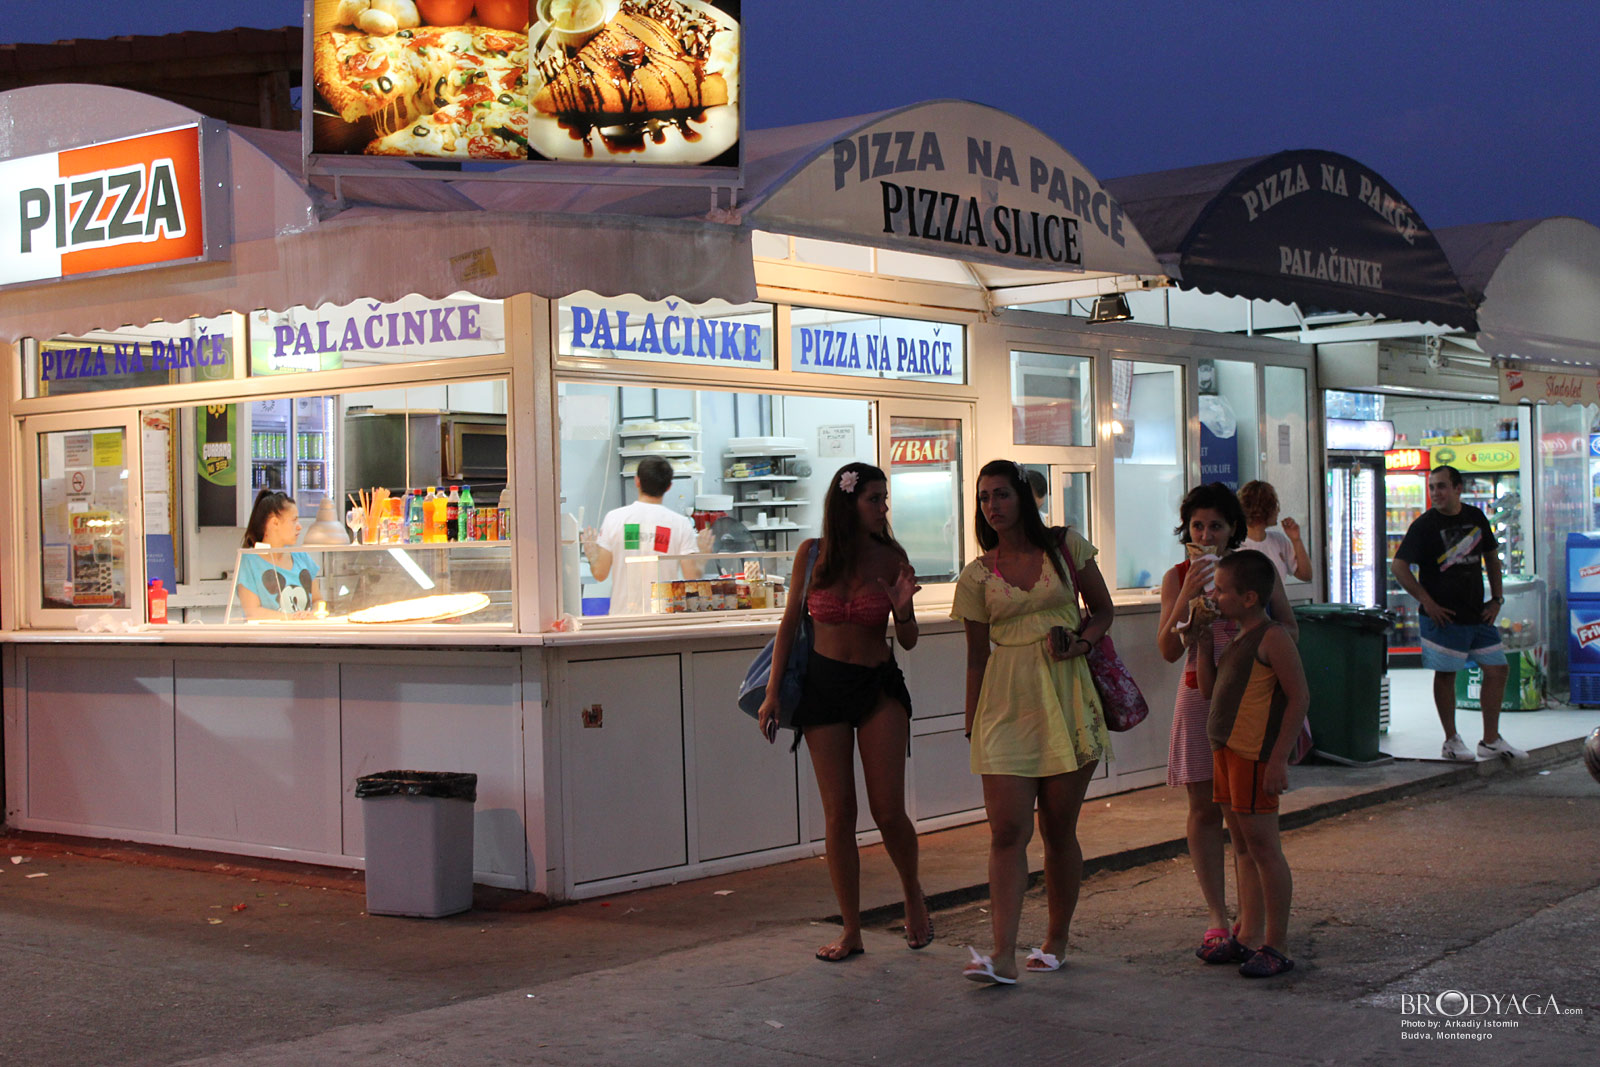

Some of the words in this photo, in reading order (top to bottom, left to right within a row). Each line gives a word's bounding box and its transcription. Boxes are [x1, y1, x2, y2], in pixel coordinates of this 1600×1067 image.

[833, 131, 945, 192] PIZZA
[967, 136, 1020, 186] NA
[20, 164, 182, 253] PIZZA
[1241, 163, 1311, 222] PIZZA
[1320, 162, 1349, 198] NA
[880, 180, 988, 247] PIZZA
[993, 205, 1081, 265] SLICE
[1279, 246, 1383, 289] PALAČINKE
[41, 344, 107, 381] PIZZA
[114, 341, 145, 375] NA
[152, 326, 226, 369] PARČE
[274, 303, 481, 357] PALAČINKE
[571, 301, 761, 363] PALAČINKE
[800, 328, 862, 369] PIZZA
[866, 334, 892, 372] NA
[897, 328, 952, 376] PARČE
[1385, 449, 1421, 469] ockta
[1477, 452, 1510, 462] RAUCH
